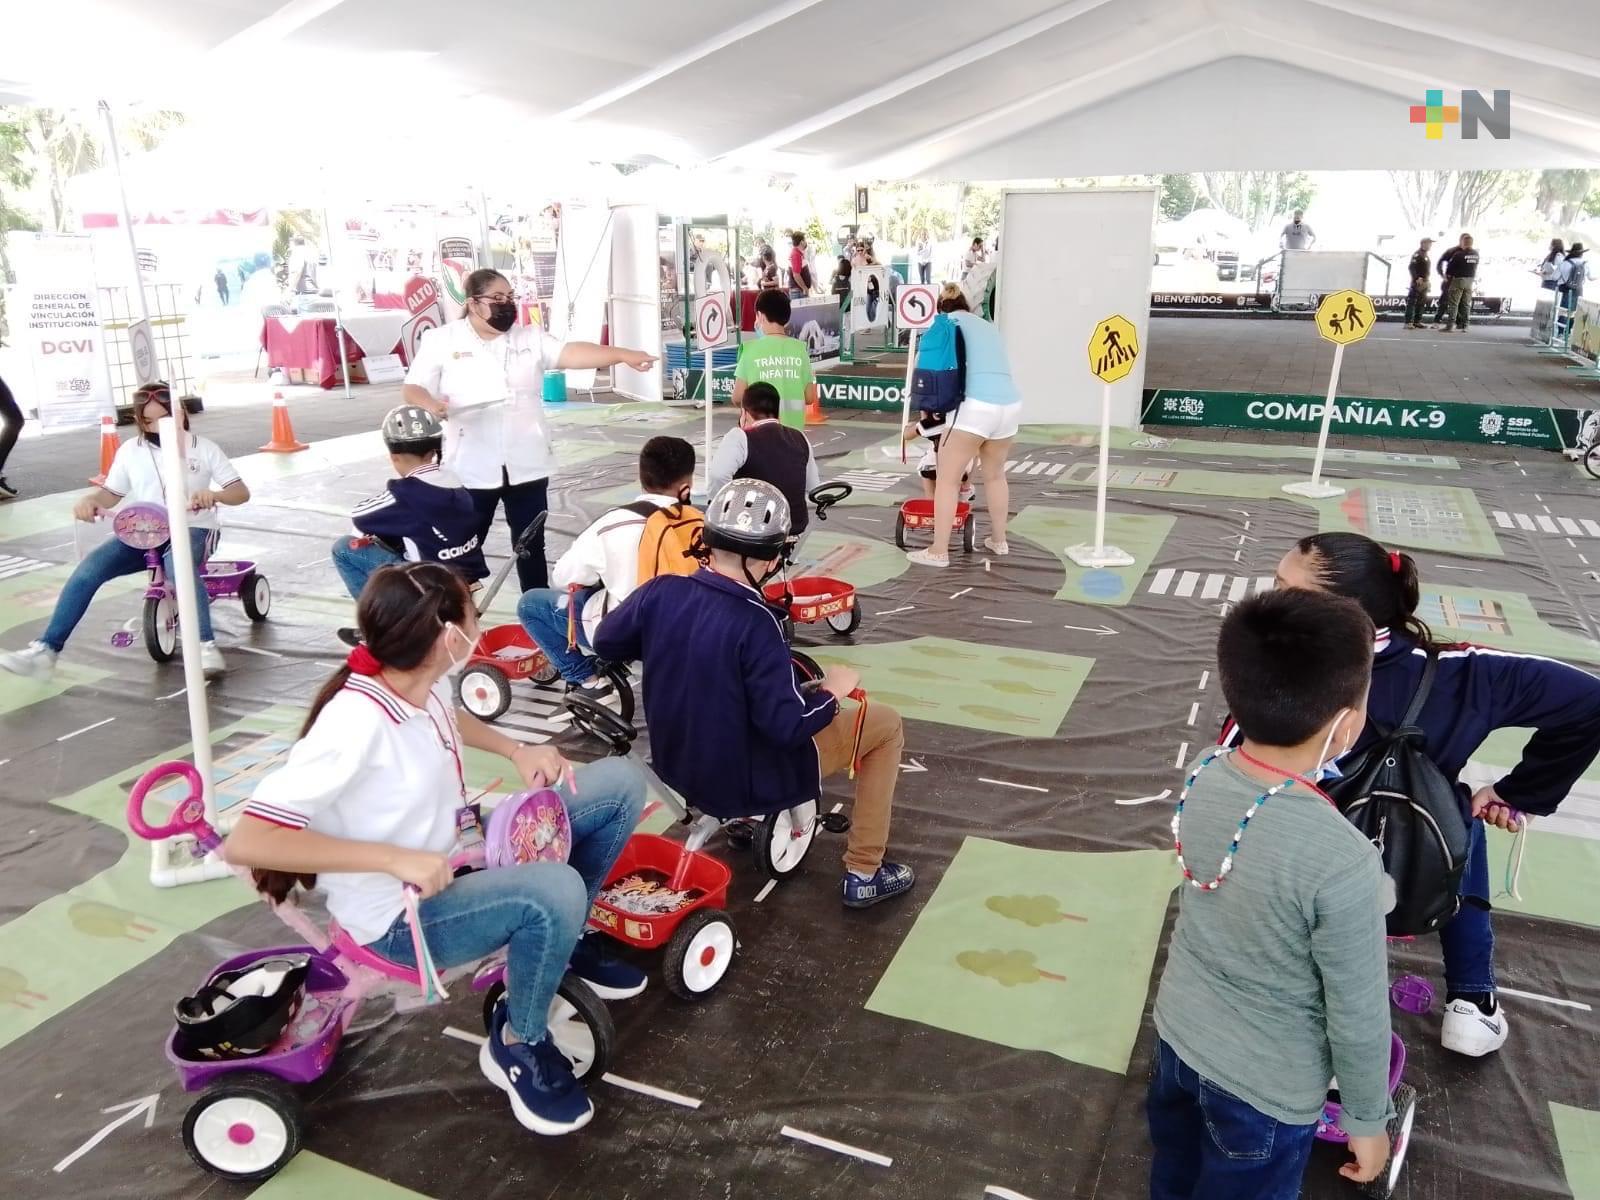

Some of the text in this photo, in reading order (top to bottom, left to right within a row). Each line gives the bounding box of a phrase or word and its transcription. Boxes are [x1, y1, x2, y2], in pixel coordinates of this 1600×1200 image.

[407, 283, 434, 310] ALTO
[1153, 294, 1223, 304] BIENVENIDOS
[29, 320, 100, 329] INSTITUCIONAL
[41, 339, 94, 355] DGVI
[1179, 396, 1204, 407] VERA
[1179, 405, 1204, 416] CRUZ
[1246, 401, 1446, 428] COMPAÑIA K-9
[1508, 417, 1533, 427] SSP
[857, 885, 877, 899] 001
